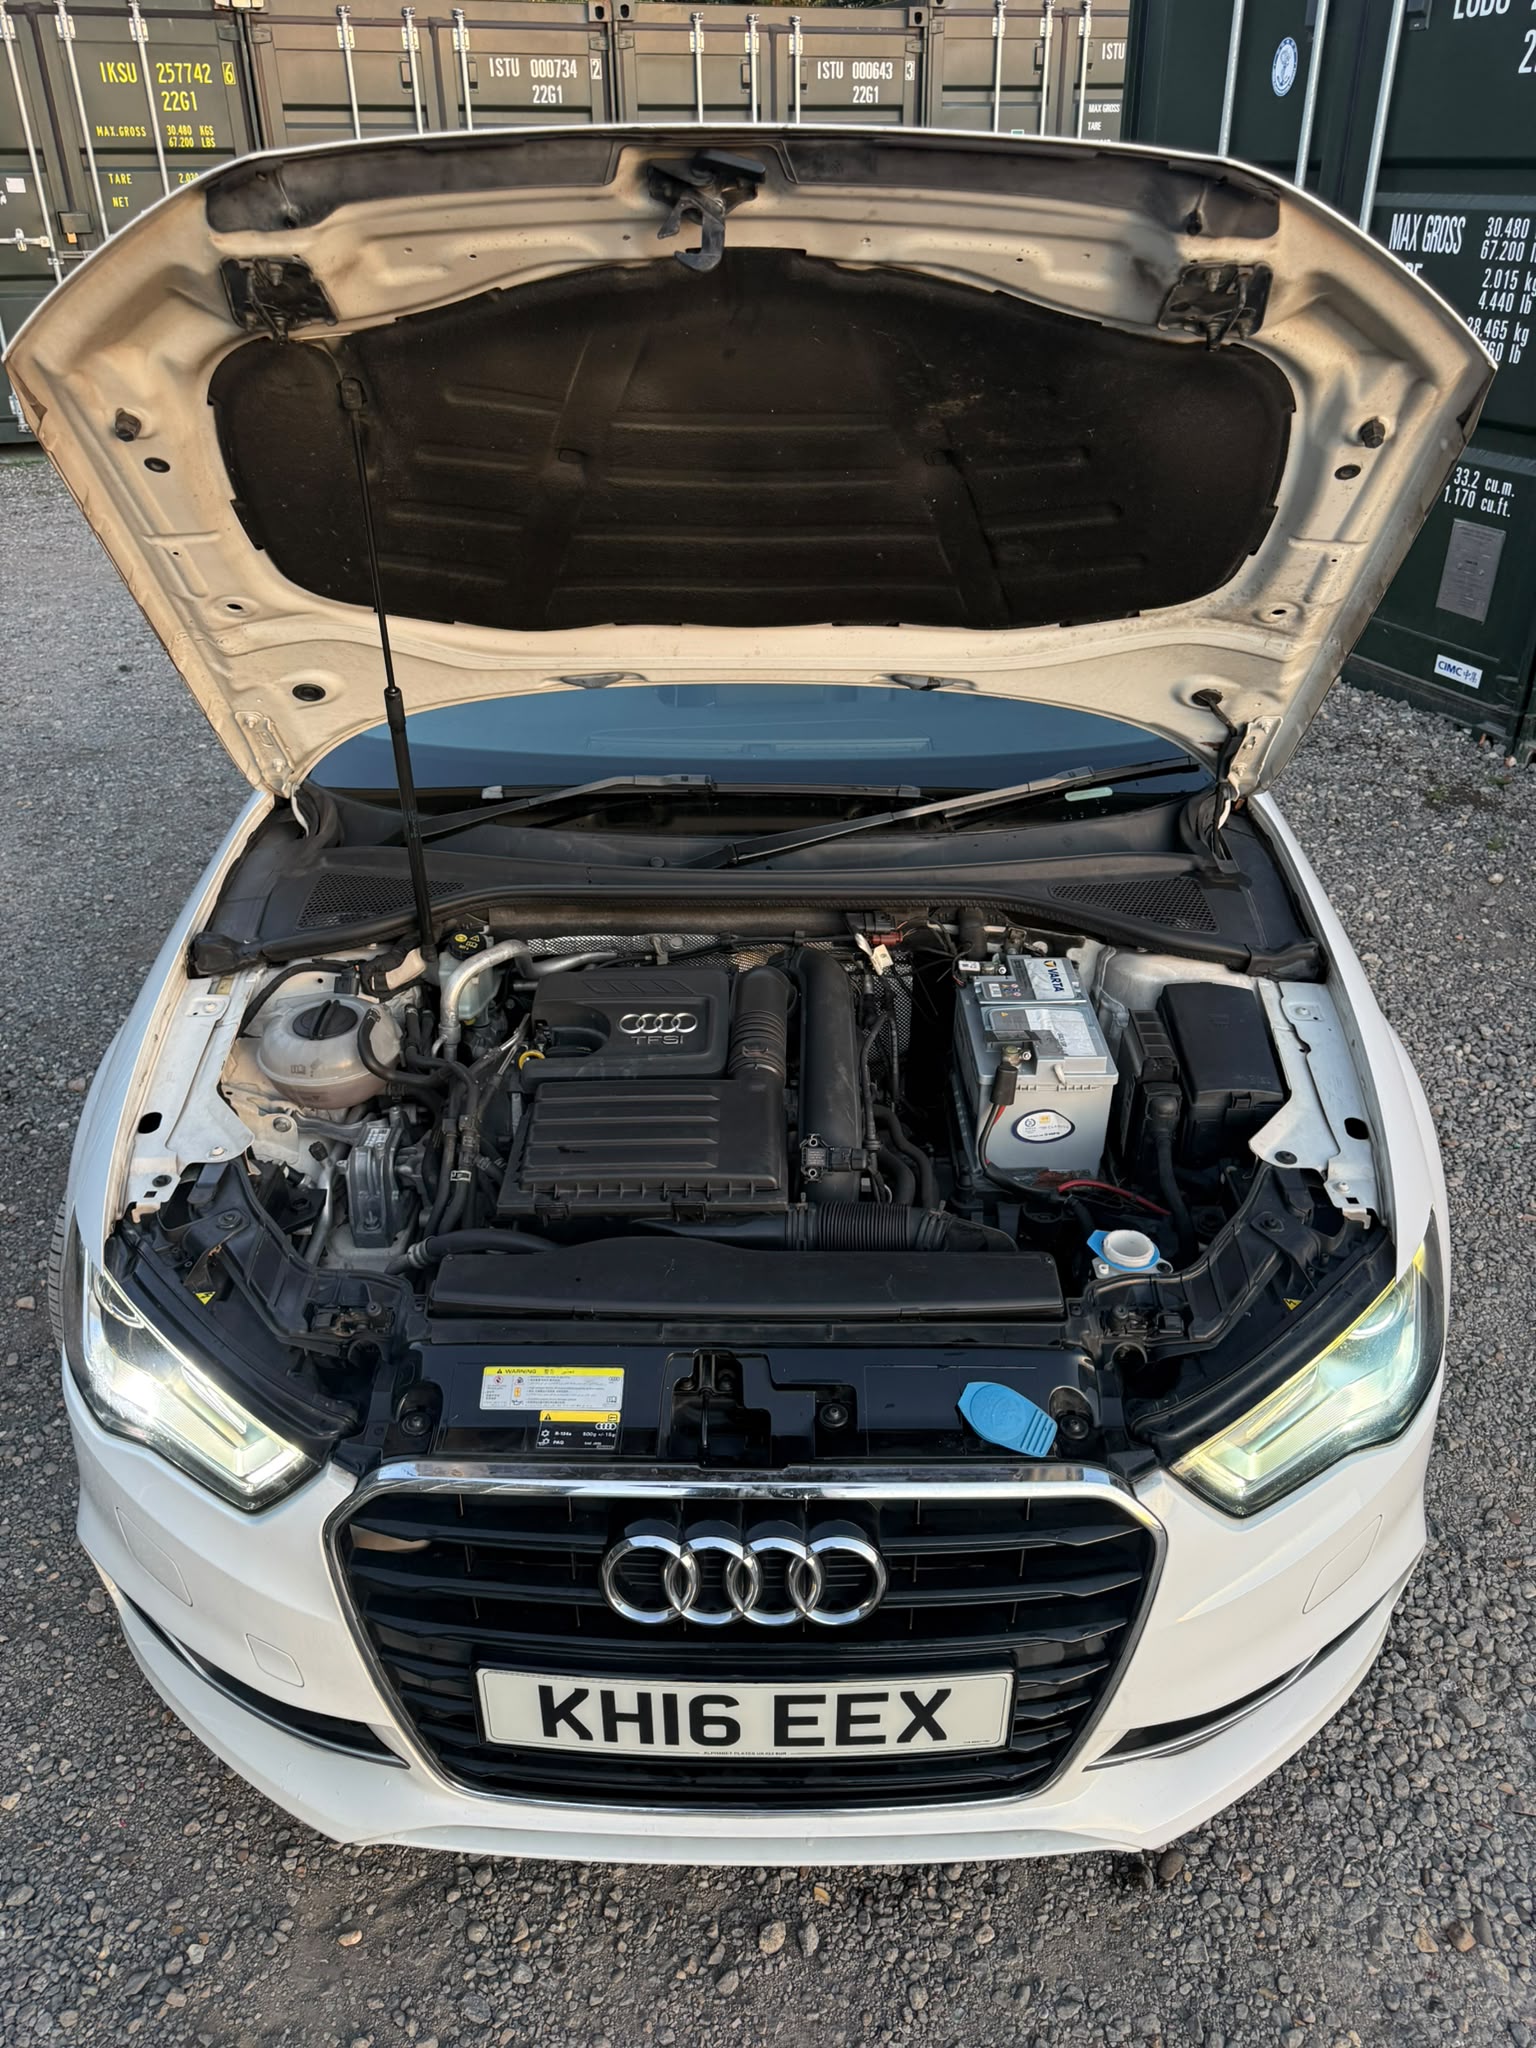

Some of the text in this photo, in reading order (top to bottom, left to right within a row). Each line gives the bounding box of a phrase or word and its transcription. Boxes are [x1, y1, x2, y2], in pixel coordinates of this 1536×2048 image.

[1101, 42, 1126, 60] ISTU
[99, 61, 236, 85] IKSU 257742 6
[489, 57, 602, 79] ISTU 000734 2
[817, 60, 915, 80] ISTU 000643 3
[161, 91, 198, 112] 22G1
[532, 84, 563, 104] 22G1
[852, 85, 879, 104] 22G1
[1088, 103, 1120, 113] MAX GROSS
[166, 125, 193, 136] 30.480
[199, 125, 215, 136] KGS
[1088, 121, 1102, 131] TARE
[168, 137, 216, 148] 67.200 LBS
[108, 173, 133, 185] TARE
[112, 197, 129, 208] NET
[1388, 213, 1531, 255] MAX GROSS 30.480
[1480, 240, 1525, 263] 67.200
[1482, 268, 1520, 291] 2.015
[1478, 290, 1532, 315] 4.440 lb
[1513, 321, 1530, 347] kg
[1508, 343, 1522, 364] lb
[1453, 466, 1515, 498] 33.2 cu.m.
[1443, 484, 1476, 509] 1.170
[1437, 660, 1463, 677] CIMC
[1047, 967, 1065, 993] VARTA
[630, 1035, 684, 1045] TFSI
[537, 1685, 953, 1748] KH16 EEX
